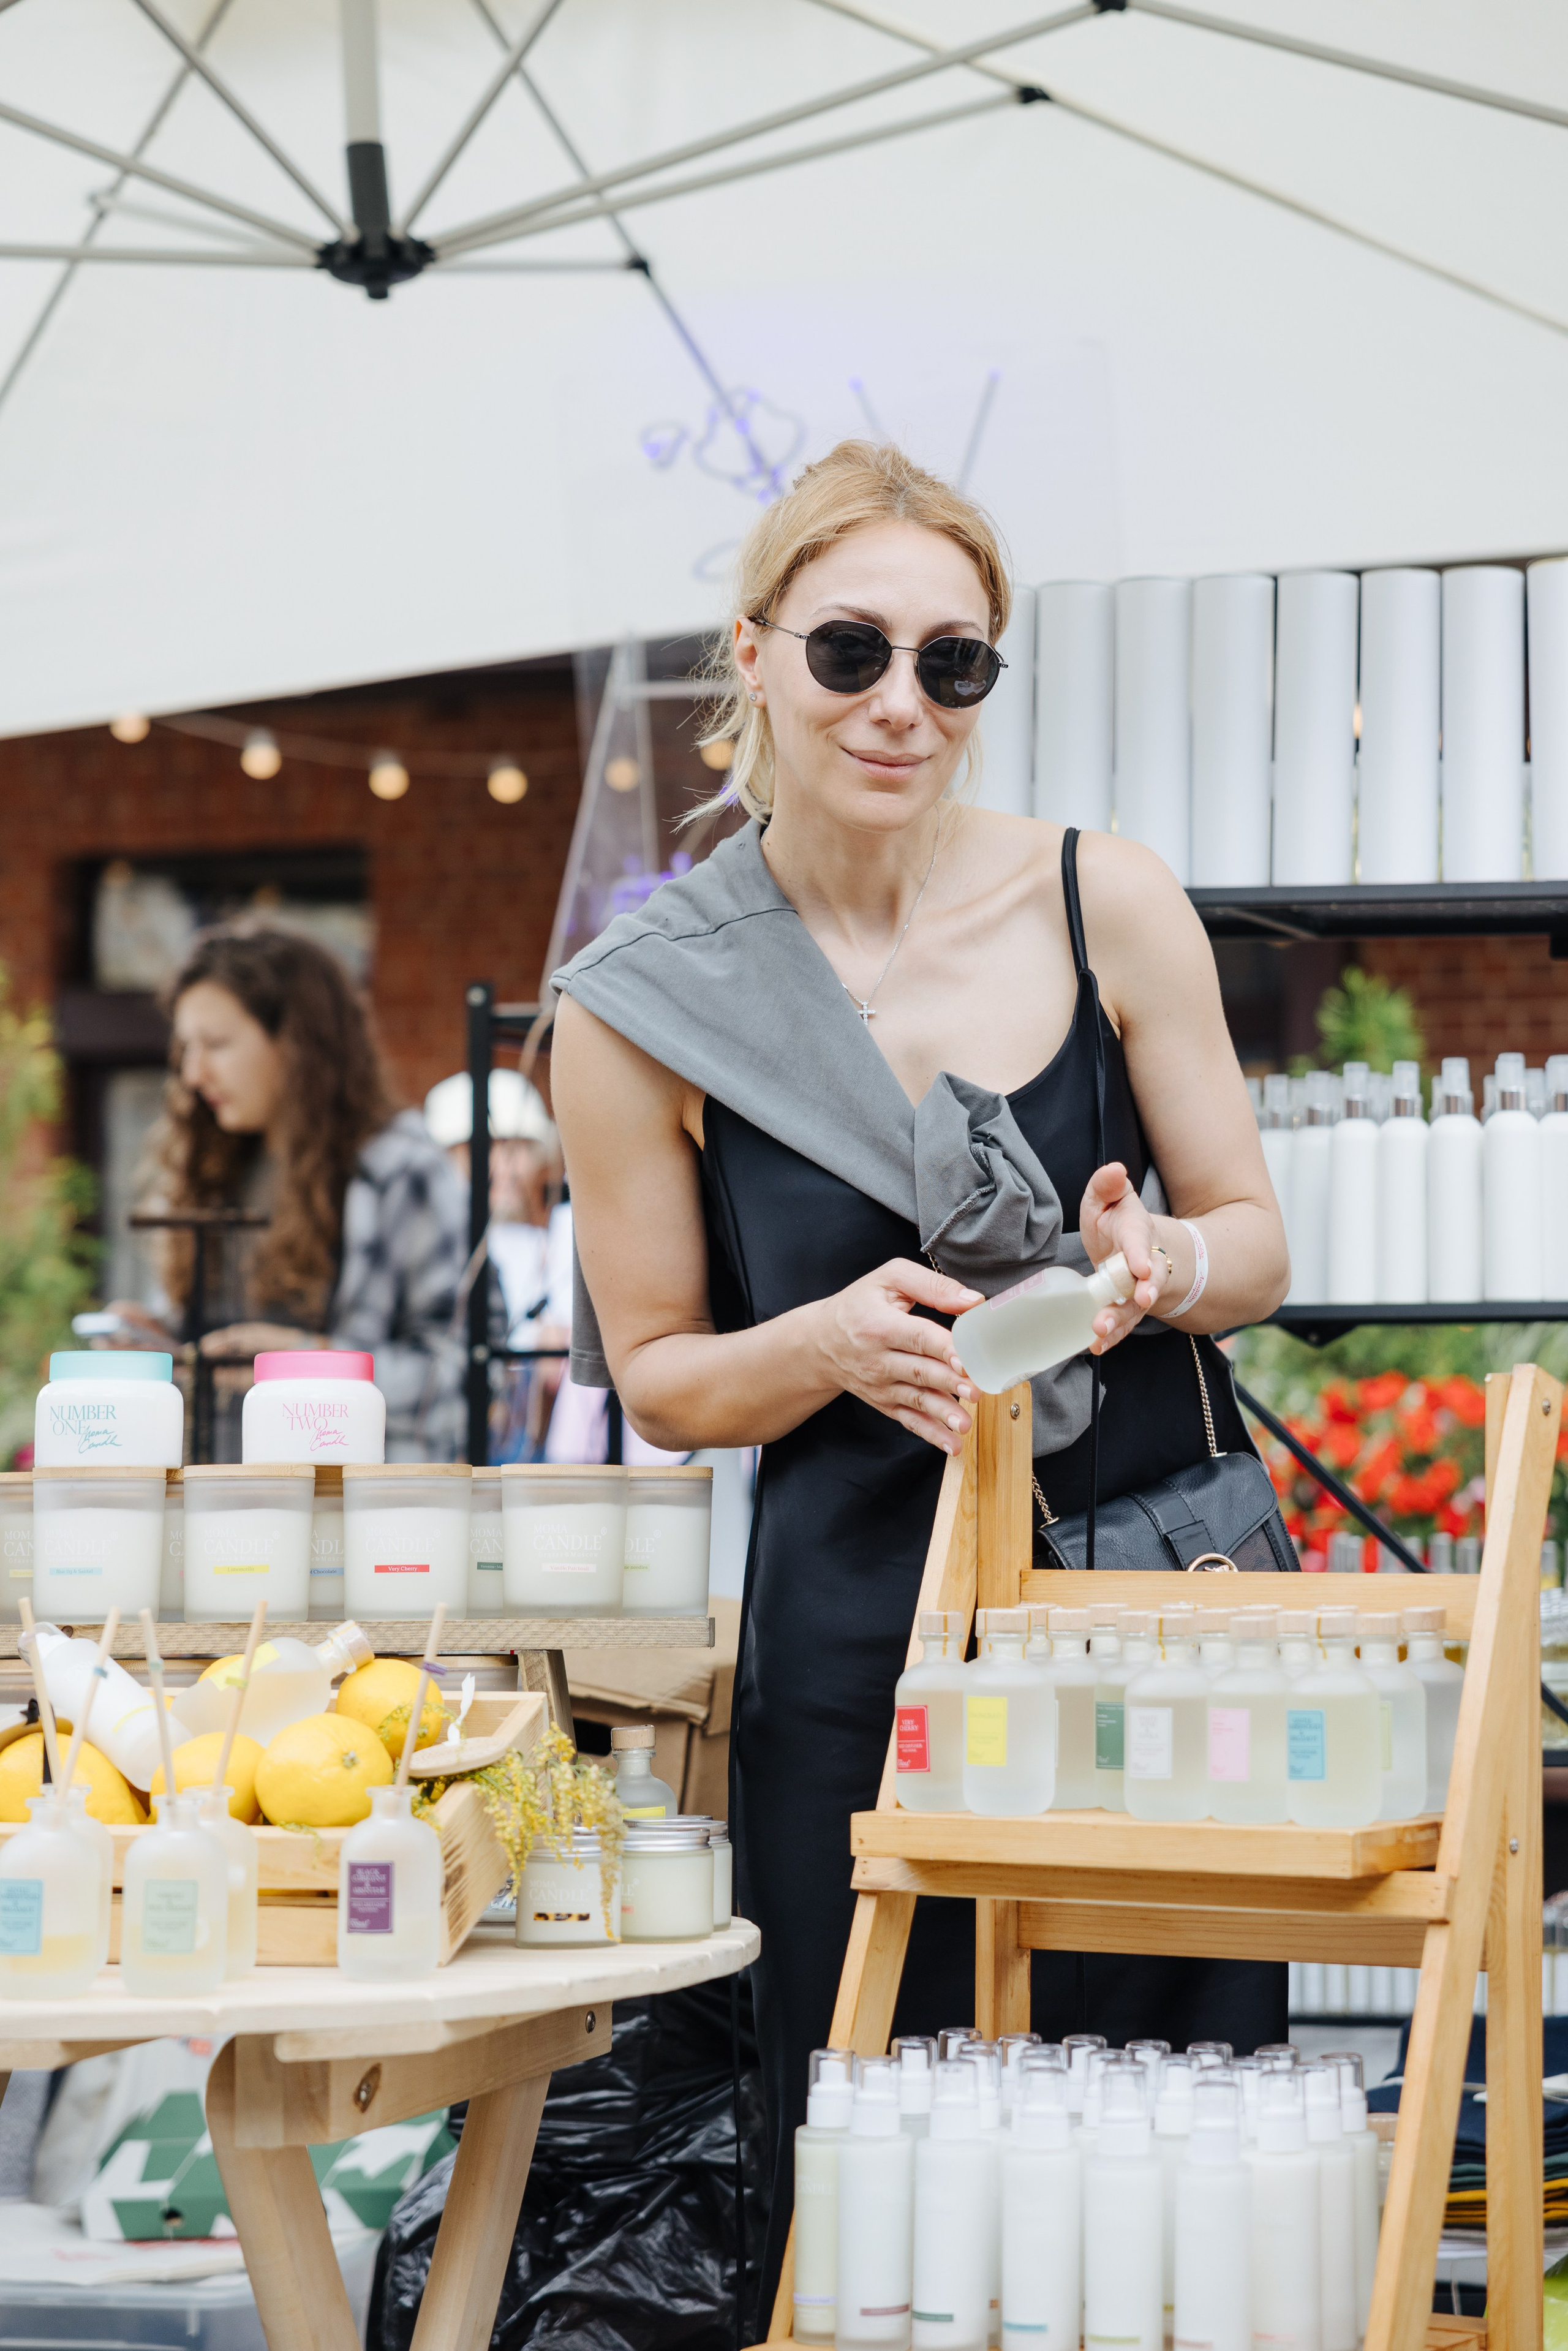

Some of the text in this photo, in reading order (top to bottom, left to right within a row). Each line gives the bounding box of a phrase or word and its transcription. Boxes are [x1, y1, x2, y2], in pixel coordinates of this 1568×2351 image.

[50, 1405, 117, 1421] NUMBER
[282, 1403, 349, 1417] NUMBER
[53, 1420, 86, 1435] ONE
[287, 1417, 328, 1430] TWO
[78, 1425, 115, 1446] Aroma
[309, 1425, 343, 1444] Aroma
[78, 1435, 123, 1454] Candle
[310, 1435, 350, 1451] Candle
[533, 1525, 568, 1533] MOMA
